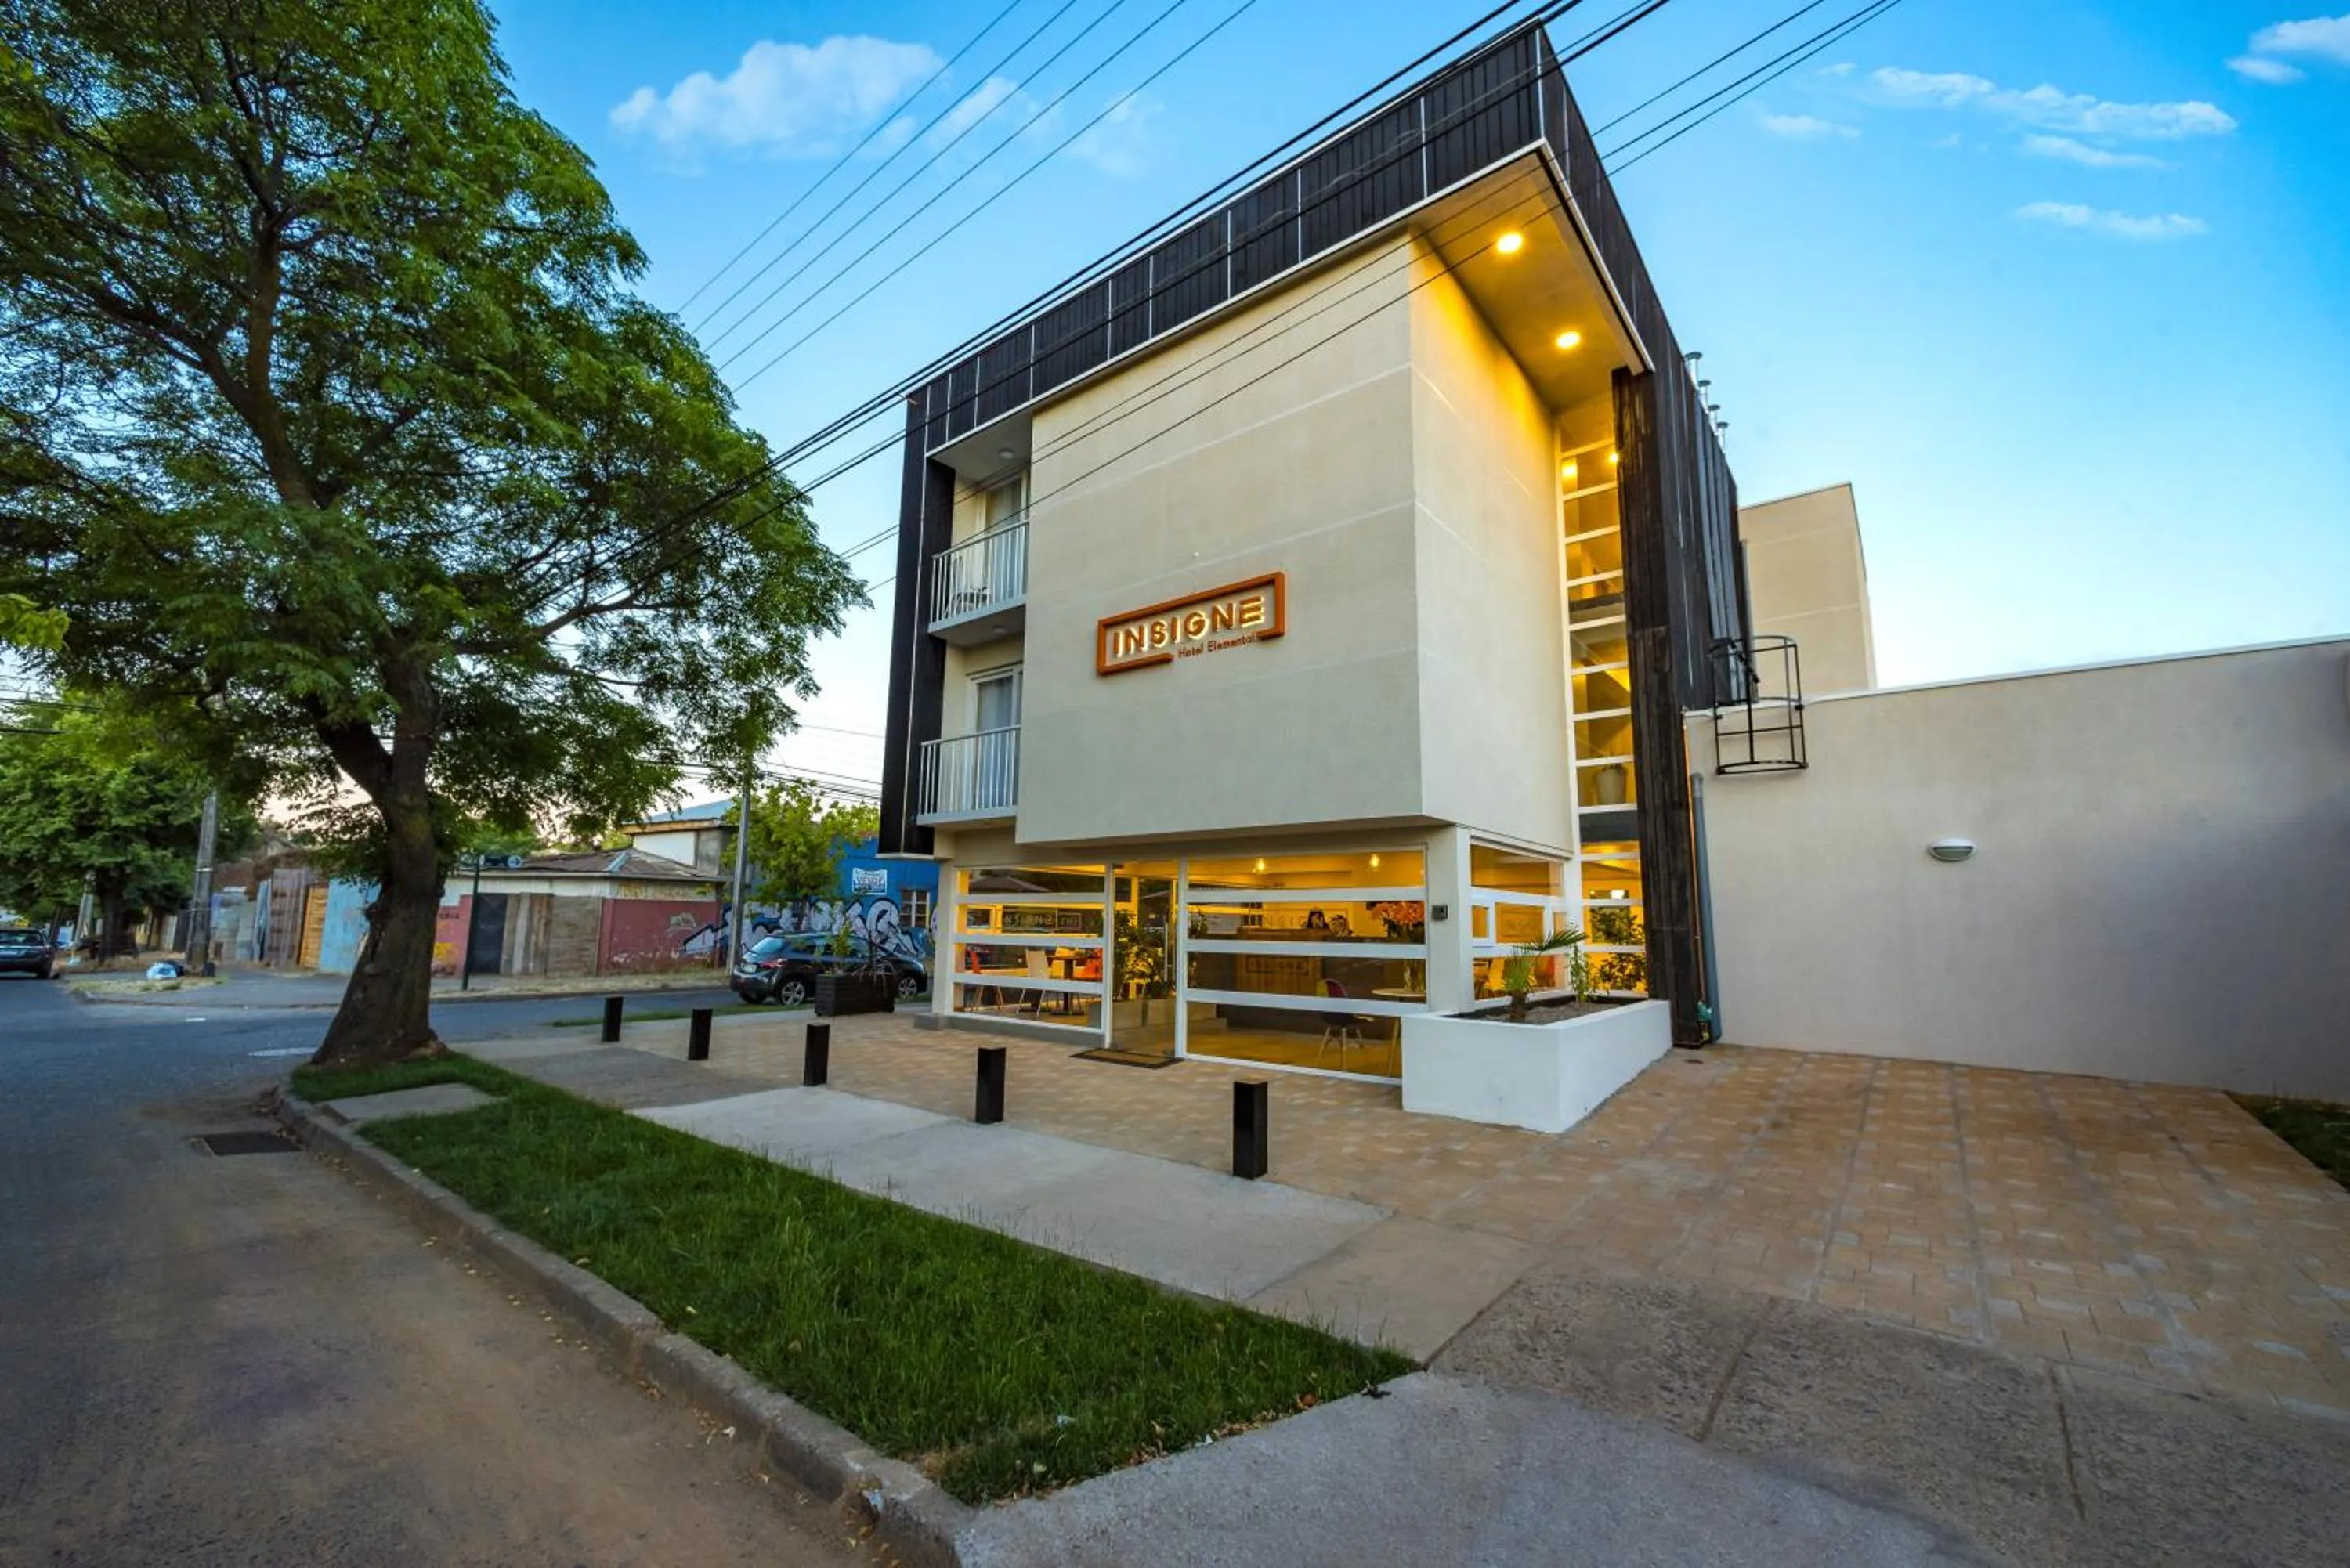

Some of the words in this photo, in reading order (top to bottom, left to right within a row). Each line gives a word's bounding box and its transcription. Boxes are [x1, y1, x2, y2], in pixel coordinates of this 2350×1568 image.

[1114, 595, 1265, 658] INSIGNE
[1178, 642, 1204, 658] Hotel
[1208, 633, 1256, 652] Elemental
